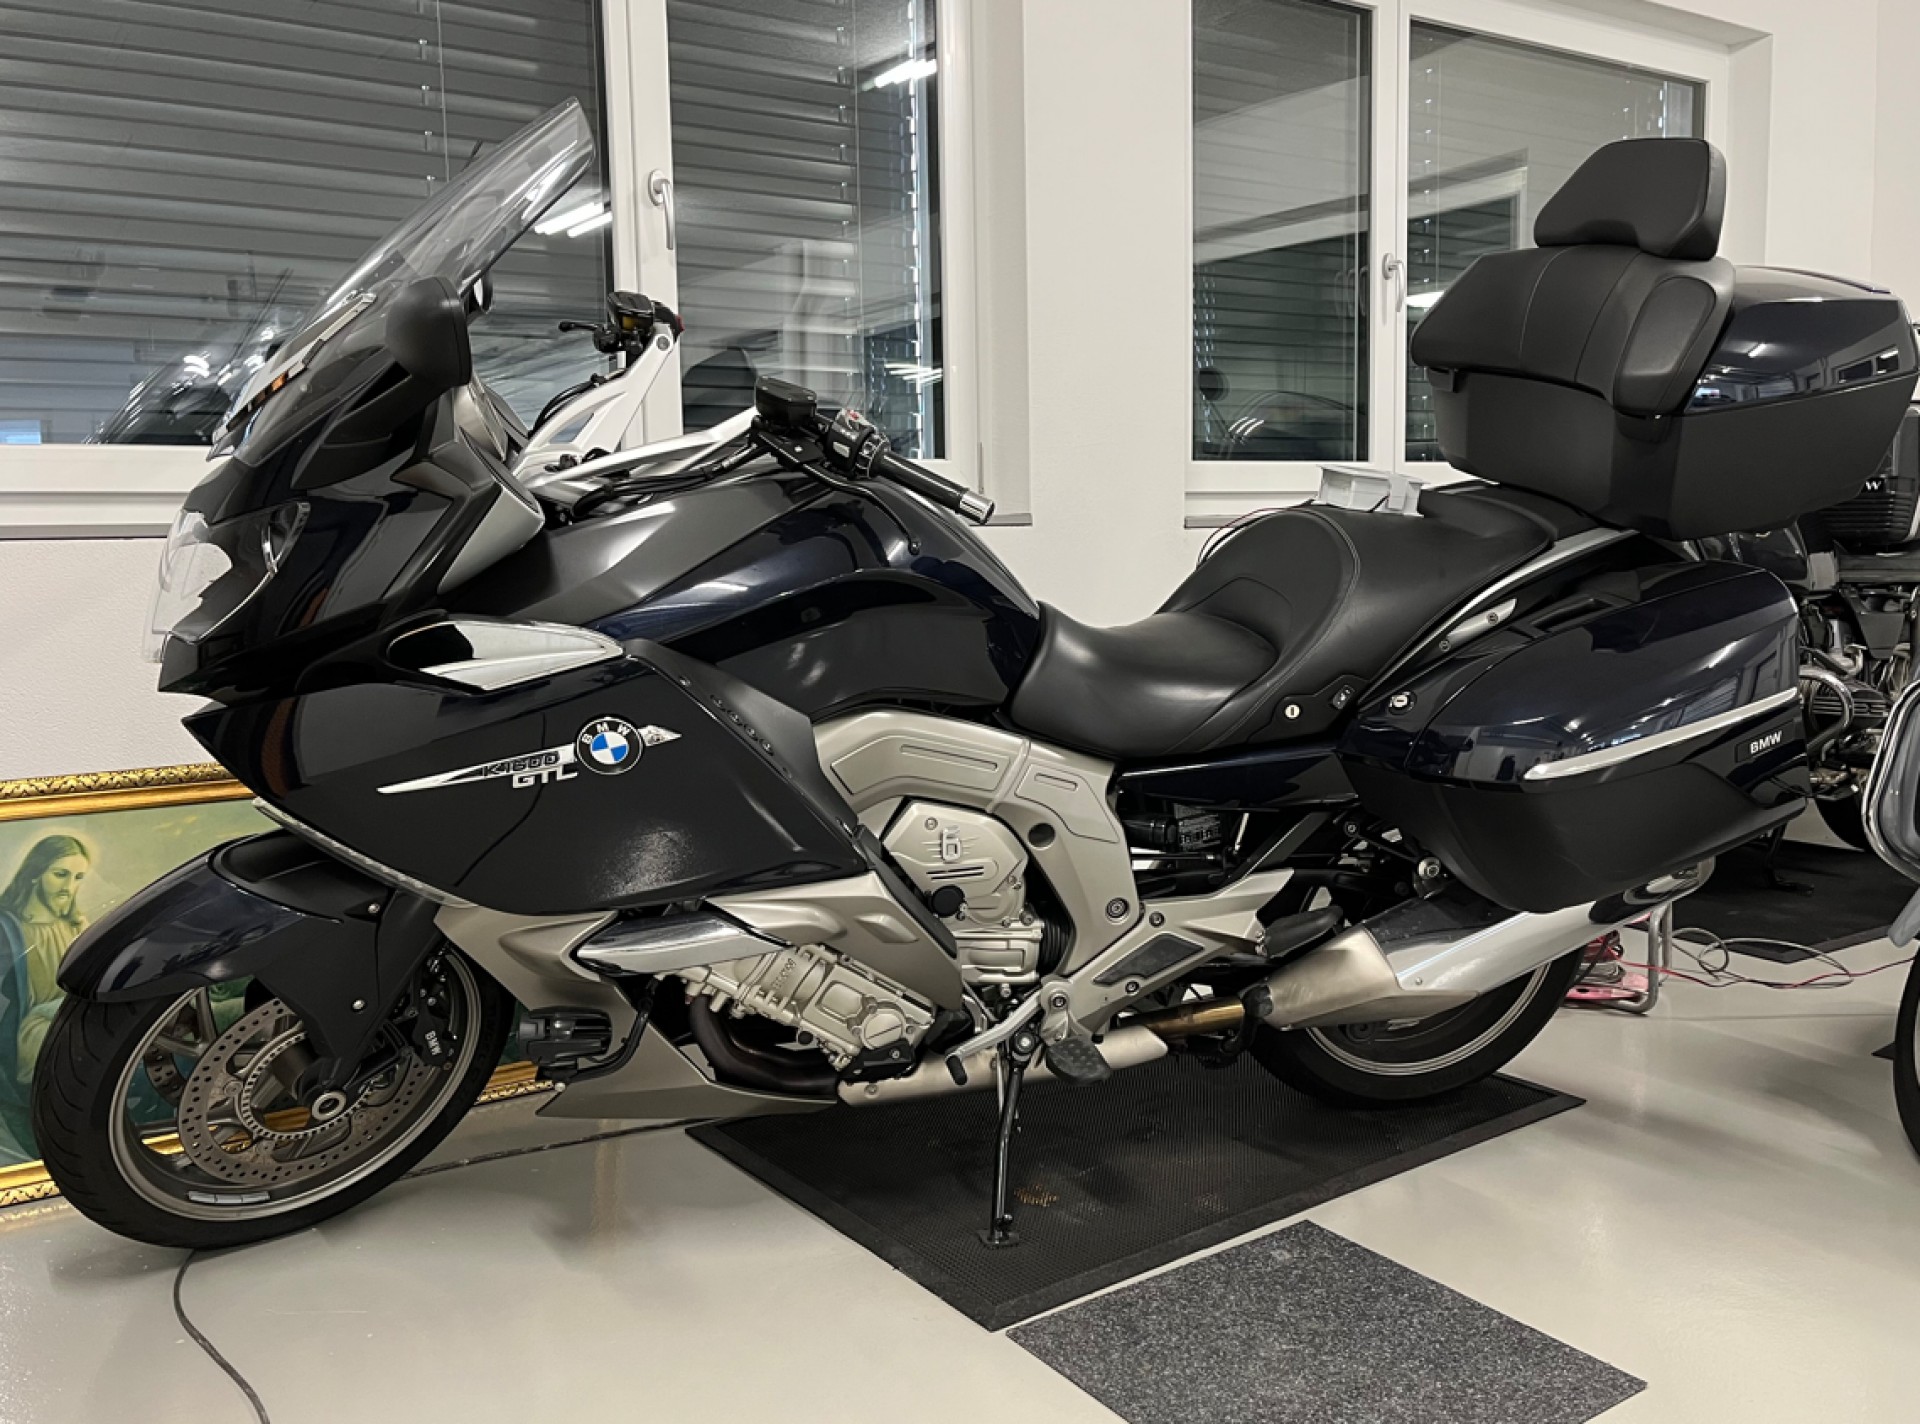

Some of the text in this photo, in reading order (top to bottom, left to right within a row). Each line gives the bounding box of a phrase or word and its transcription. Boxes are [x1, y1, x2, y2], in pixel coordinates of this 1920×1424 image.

[581, 721, 632, 745] BMW
[1750, 730, 1783, 755] BMW
[512, 764, 578, 789] GTL
[424, 1030, 442, 1056] BMW
